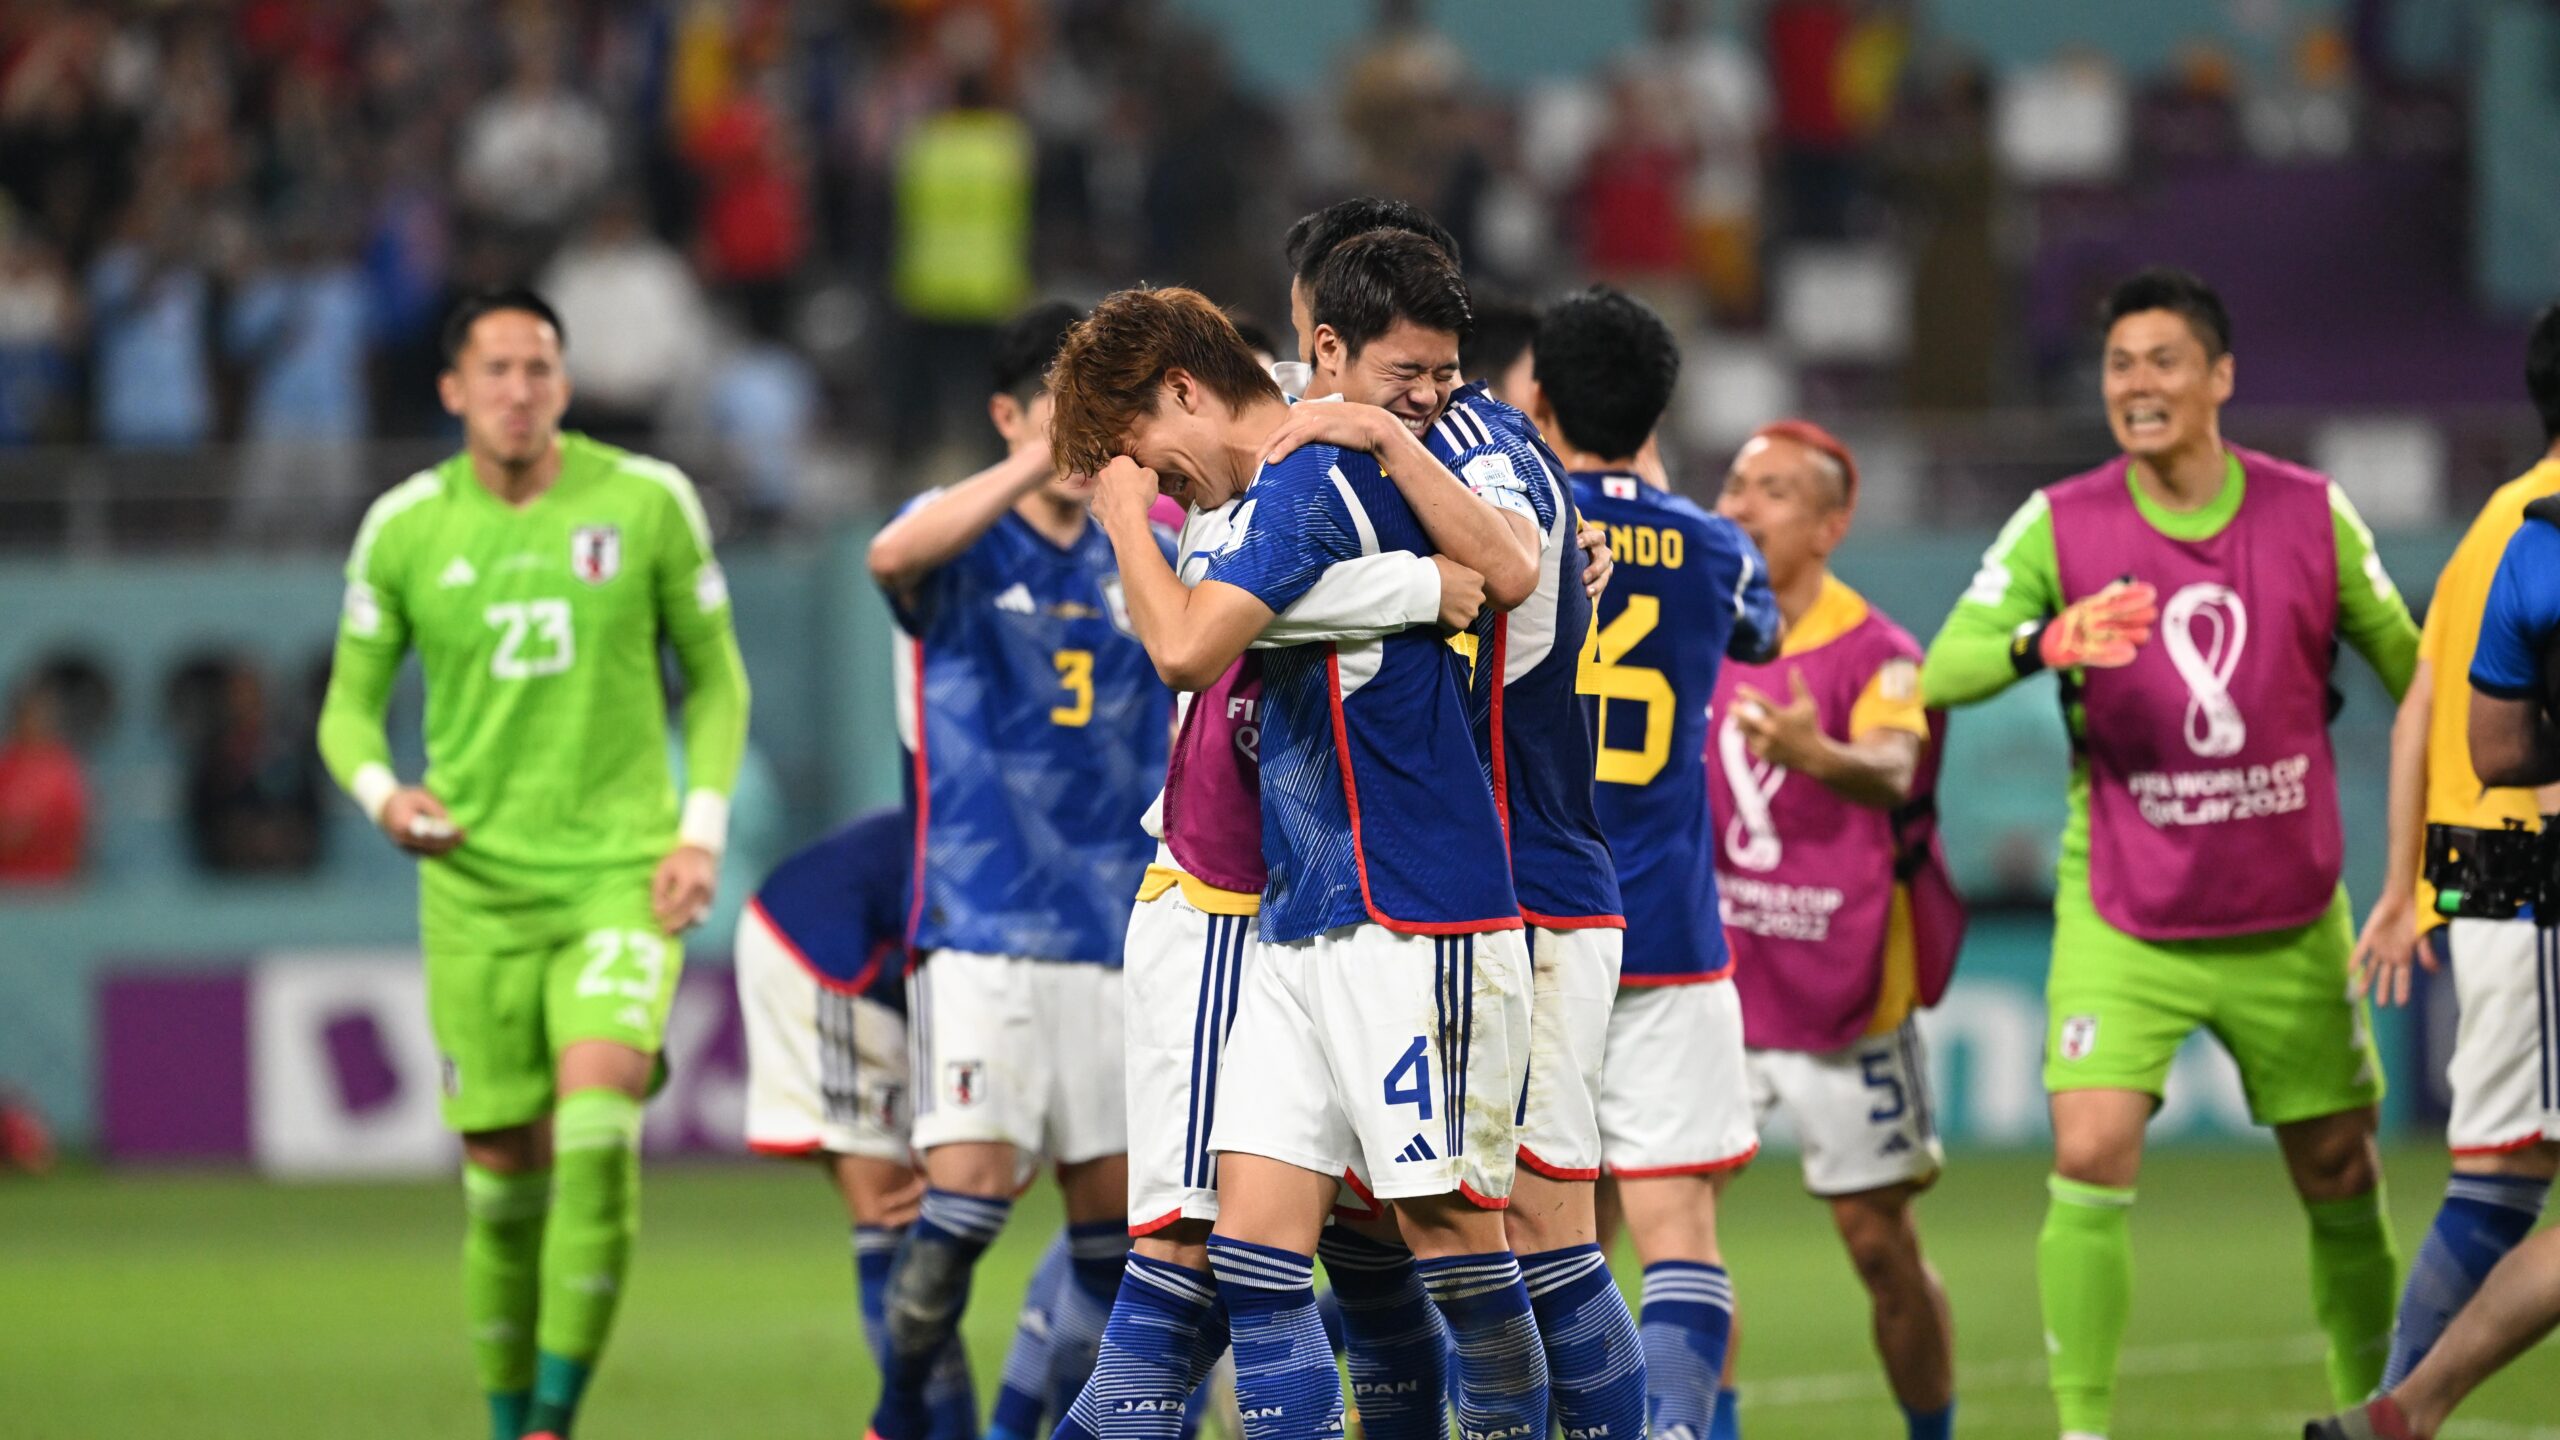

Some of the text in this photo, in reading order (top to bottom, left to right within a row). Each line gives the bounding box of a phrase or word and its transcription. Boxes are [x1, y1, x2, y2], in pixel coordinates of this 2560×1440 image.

[1589, 521, 1683, 569] NDO
[485, 599, 575, 679] 23
[1050, 649, 1094, 727] 3
[1595, 593, 1676, 786] 6
[2172, 764, 2269, 797] WORLD
[2271, 754, 2309, 789] CUP
[576, 928, 664, 1002] 23
[1383, 1035, 1433, 1120] 4
[1860, 1051, 1905, 1122] 5
[1352, 1380, 1417, 1396] PAN
